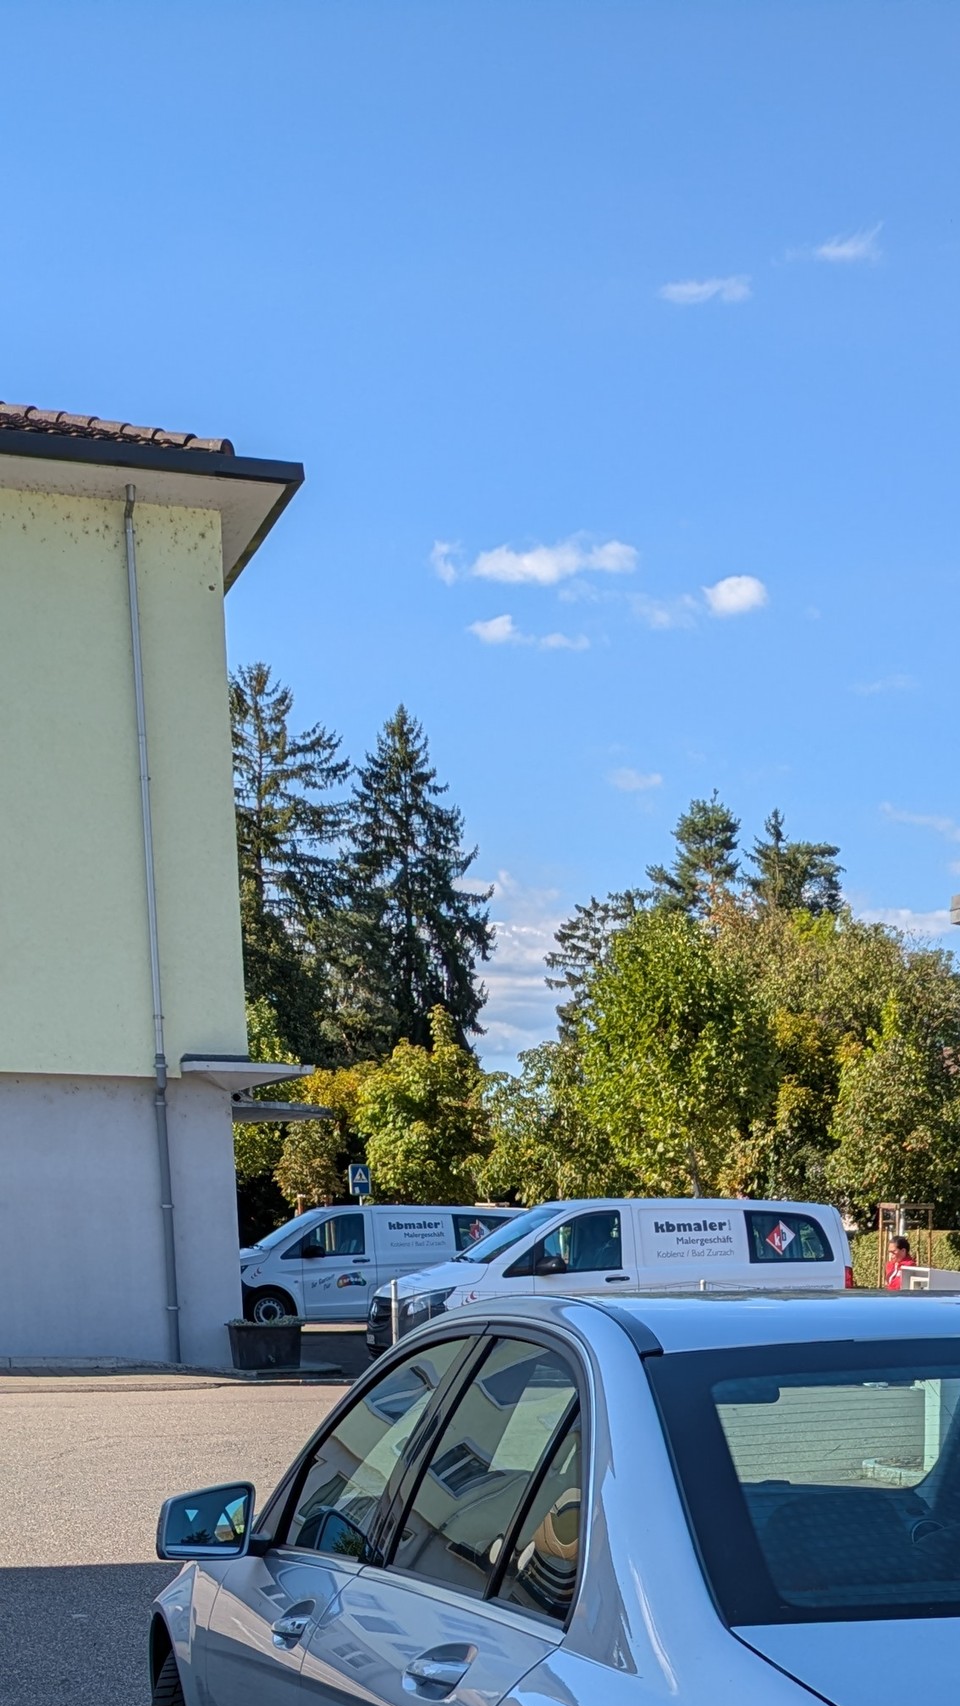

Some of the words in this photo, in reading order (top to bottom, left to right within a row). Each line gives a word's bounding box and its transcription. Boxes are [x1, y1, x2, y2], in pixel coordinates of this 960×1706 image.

[388, 1220, 440, 1230] kbmaler
[654, 1219, 727, 1233] kbmaler
[404, 1231, 445, 1239] Malergeschäft
[676, 1235, 733, 1246] Malergeschäft
[656, 1250, 685, 1258] Koblenz
[692, 1249, 705, 1258] Bad
[706, 1248, 735, 1257] Zurzach
